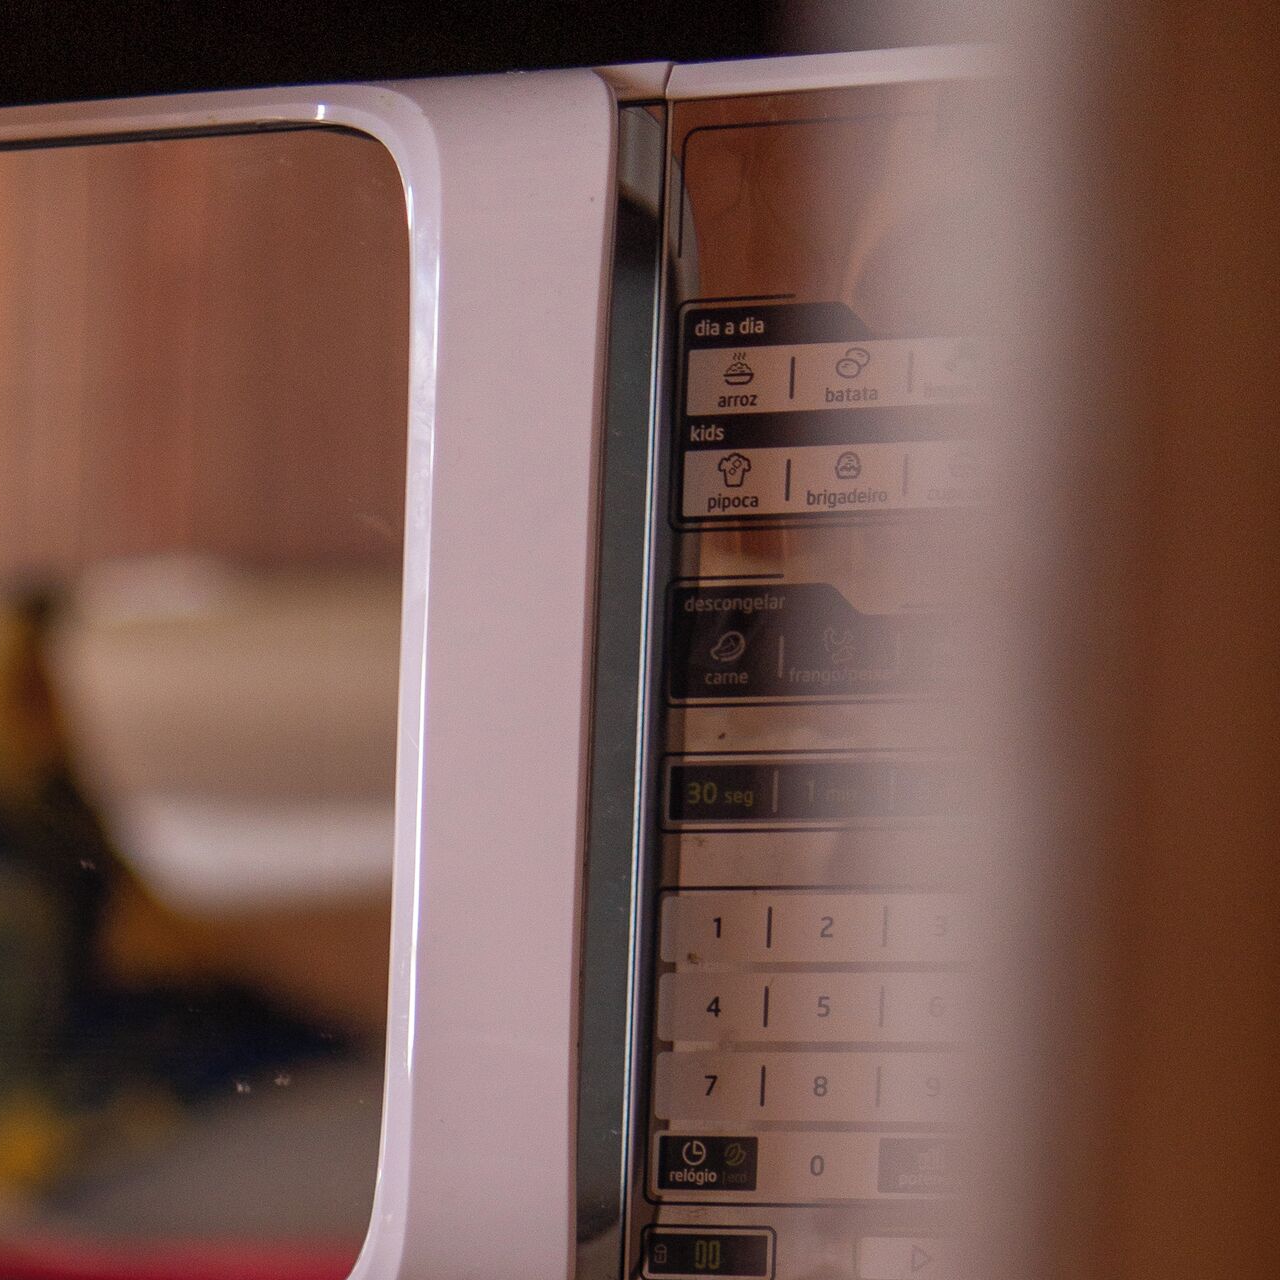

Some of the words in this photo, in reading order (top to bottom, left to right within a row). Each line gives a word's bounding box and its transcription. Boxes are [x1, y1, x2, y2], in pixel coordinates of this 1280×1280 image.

[694, 319, 720, 338] dia
[724, 323, 735, 336] a
[739, 317, 765, 335] dia
[717, 392, 758, 408] arroz
[824, 386, 879, 403] batata
[690, 424, 725, 442] kids
[707, 493, 759, 512] pipoca
[806, 488, 888, 508] brigadeiro
[684, 593, 786, 614] descongelar
[704, 669, 749, 685] carne
[687, 781, 718, 804] 30
[724, 788, 754, 807] seg
[712, 916, 723, 939] 1
[820, 915, 835, 938] 2
[705, 995, 722, 1018] 4
[816, 995, 831, 1018] 5
[704, 1074, 719, 1097] 7
[812, 1074, 828, 1097] 8
[810, 1154, 825, 1177] 0
[669, 1168, 718, 1186] relógio
